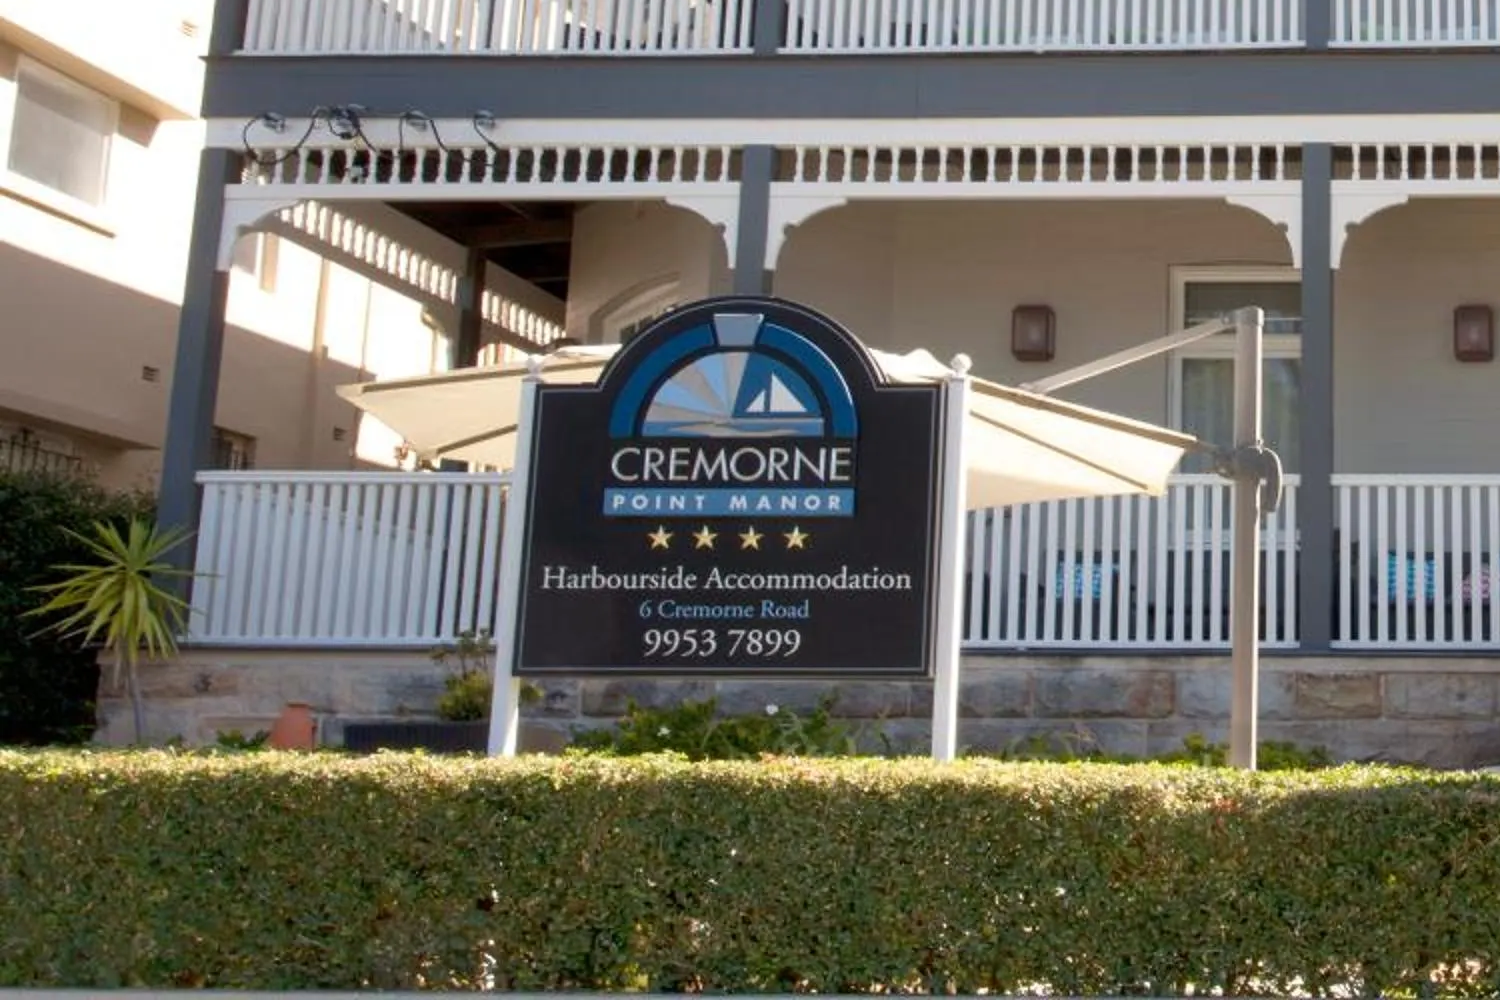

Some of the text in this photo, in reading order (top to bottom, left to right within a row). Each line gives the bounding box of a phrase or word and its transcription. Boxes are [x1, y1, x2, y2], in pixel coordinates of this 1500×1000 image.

[611, 446, 851, 481] CREMORNE
[613, 493, 842, 511] POINT MANOR
[541, 566, 911, 590] Harbourside Accommodation
[639, 599, 810, 619] 6 Cremorne Road
[643, 629, 801, 657] 9953 7899
